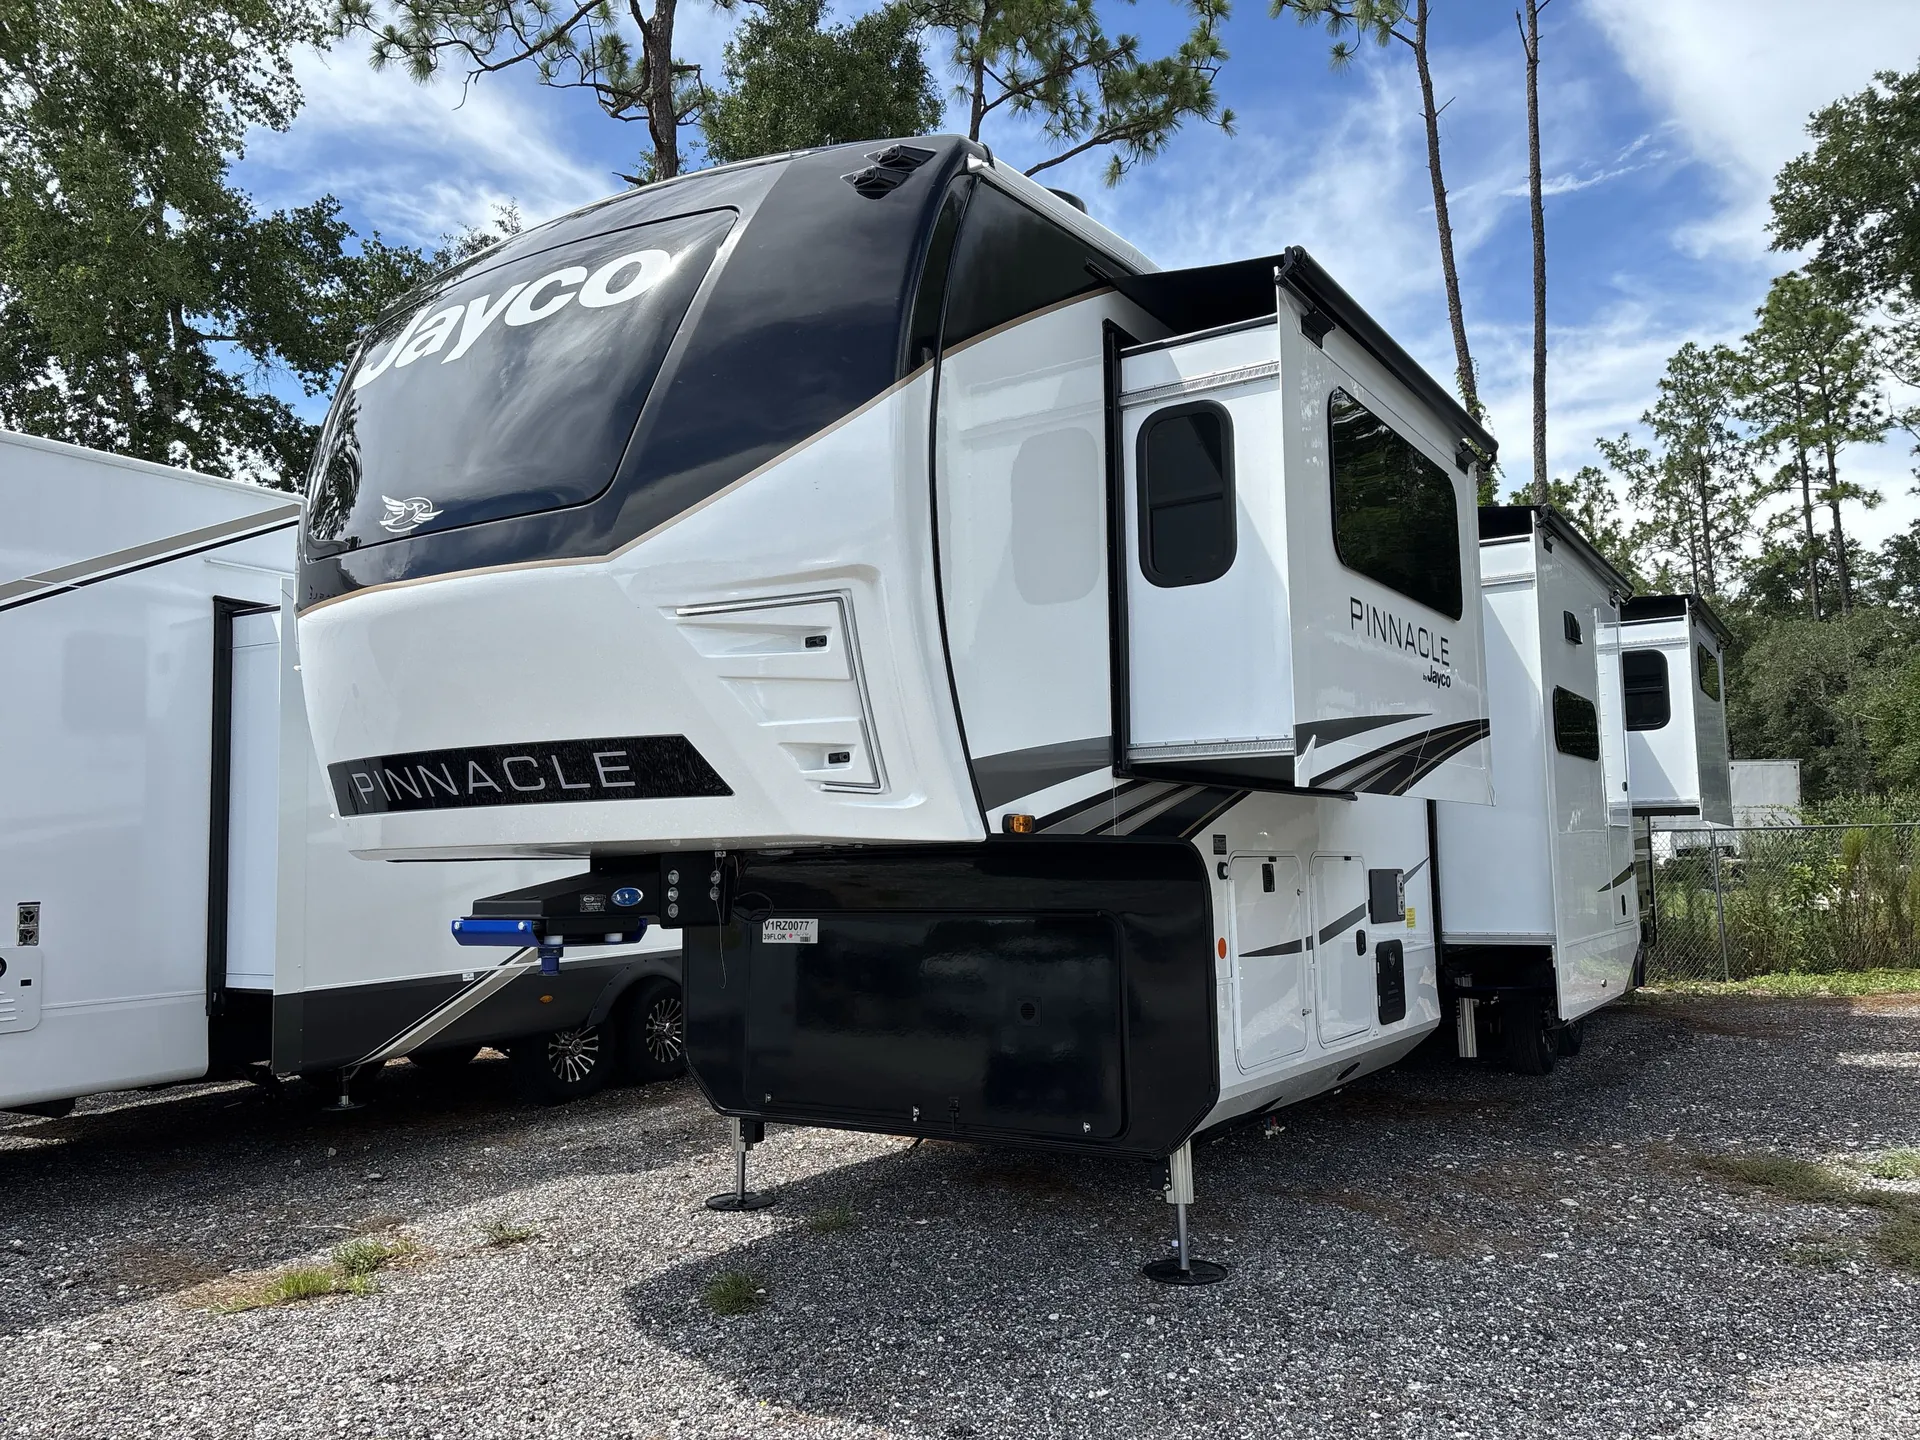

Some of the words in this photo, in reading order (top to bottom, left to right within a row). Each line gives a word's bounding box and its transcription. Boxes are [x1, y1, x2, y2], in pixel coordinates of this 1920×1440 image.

[352, 249, 672, 391] Jayco
[1350, 596, 1450, 667] PINNACLE
[1427, 664, 1451, 689] Jayco
[351, 750, 636, 804] PINNACLE
[764, 920, 809, 930] V1RZ0077
